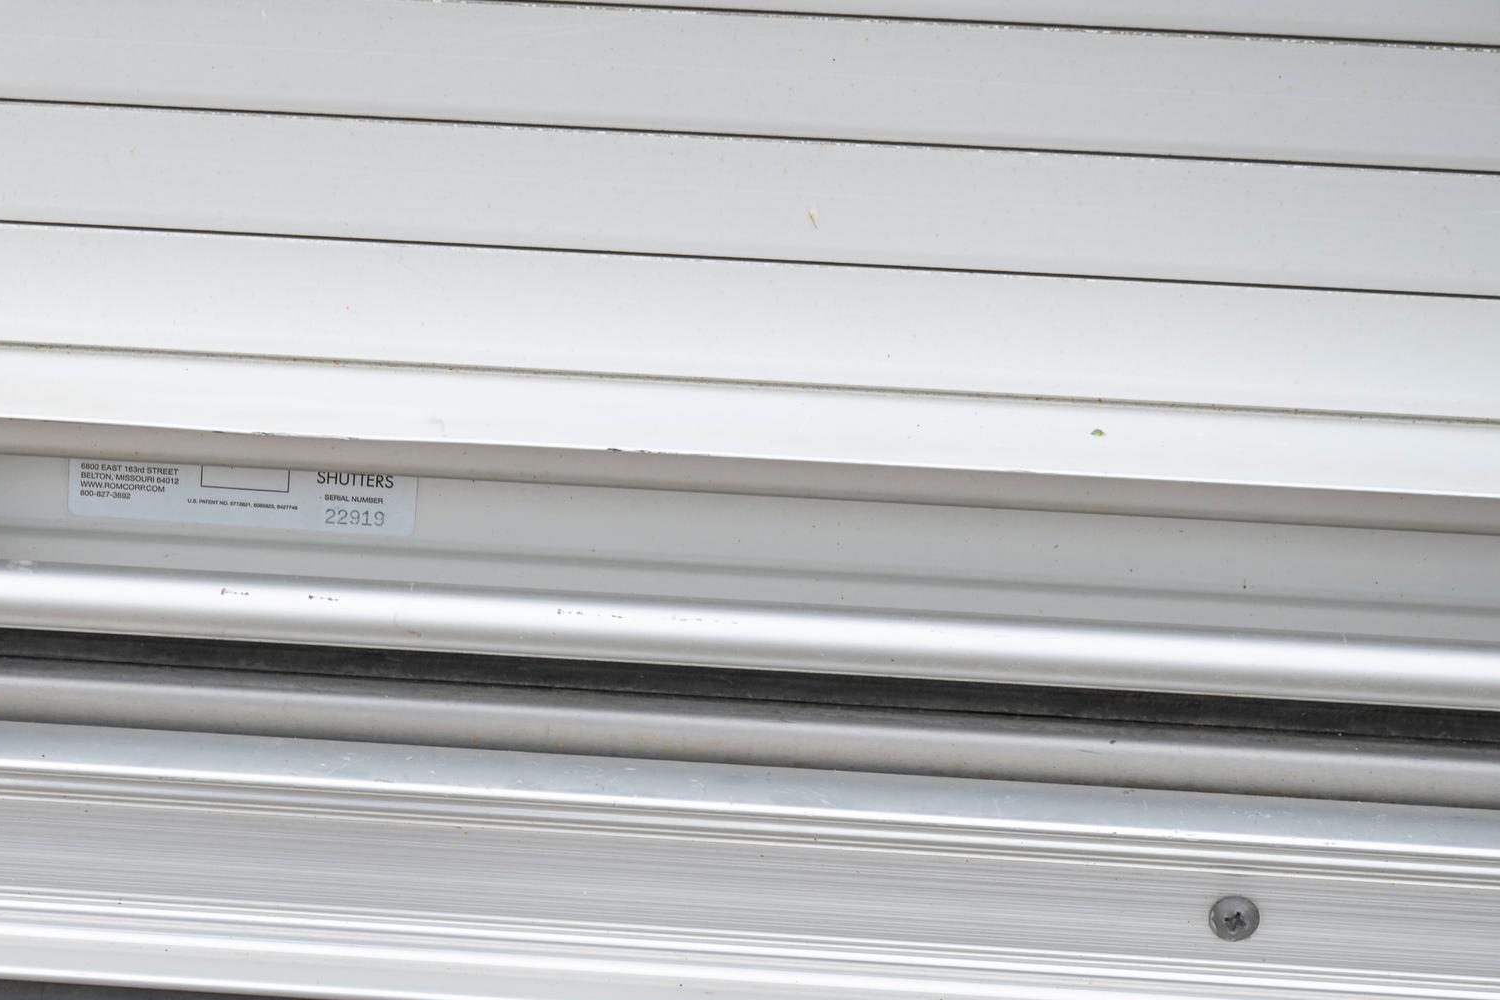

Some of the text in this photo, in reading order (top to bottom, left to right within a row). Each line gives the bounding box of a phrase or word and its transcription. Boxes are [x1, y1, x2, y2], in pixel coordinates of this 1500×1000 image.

[101, 463, 123, 472] EAST
[124, 465, 145, 474] 163rd
[146, 467, 180, 476] STREET
[80, 471, 180, 485] BELTON, MISSOURI 64012
[316, 471, 395, 490] SHUTTERS
[80, 480, 166, 493] WWW.ROMCORP.COM
[79, 489, 131, 499] 800-827-3692
[324, 493, 384, 505] SERIAL NUMBER
[324, 507, 386, 528] 22919
